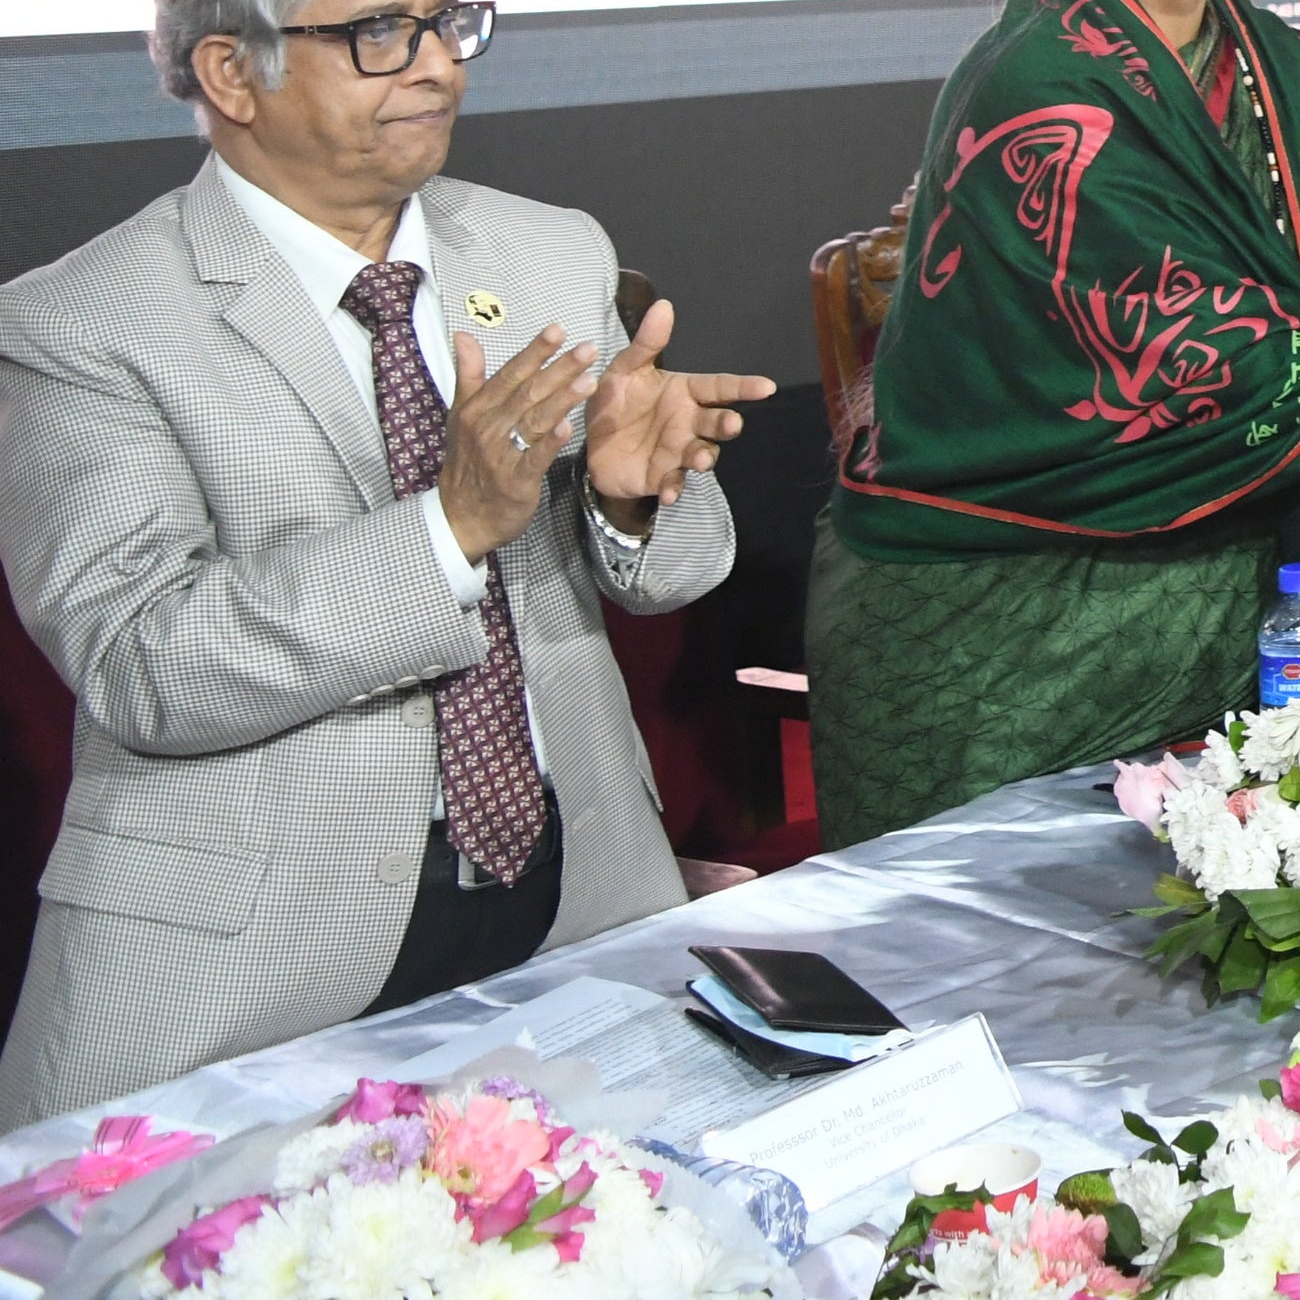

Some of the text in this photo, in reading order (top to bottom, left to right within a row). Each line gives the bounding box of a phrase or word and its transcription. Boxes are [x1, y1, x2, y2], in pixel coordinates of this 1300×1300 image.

[842, 1105, 868, 1123] Md.
[871, 1058, 965, 1110] Akhtaruzzaman
[828, 1130, 852, 1149] Vice
